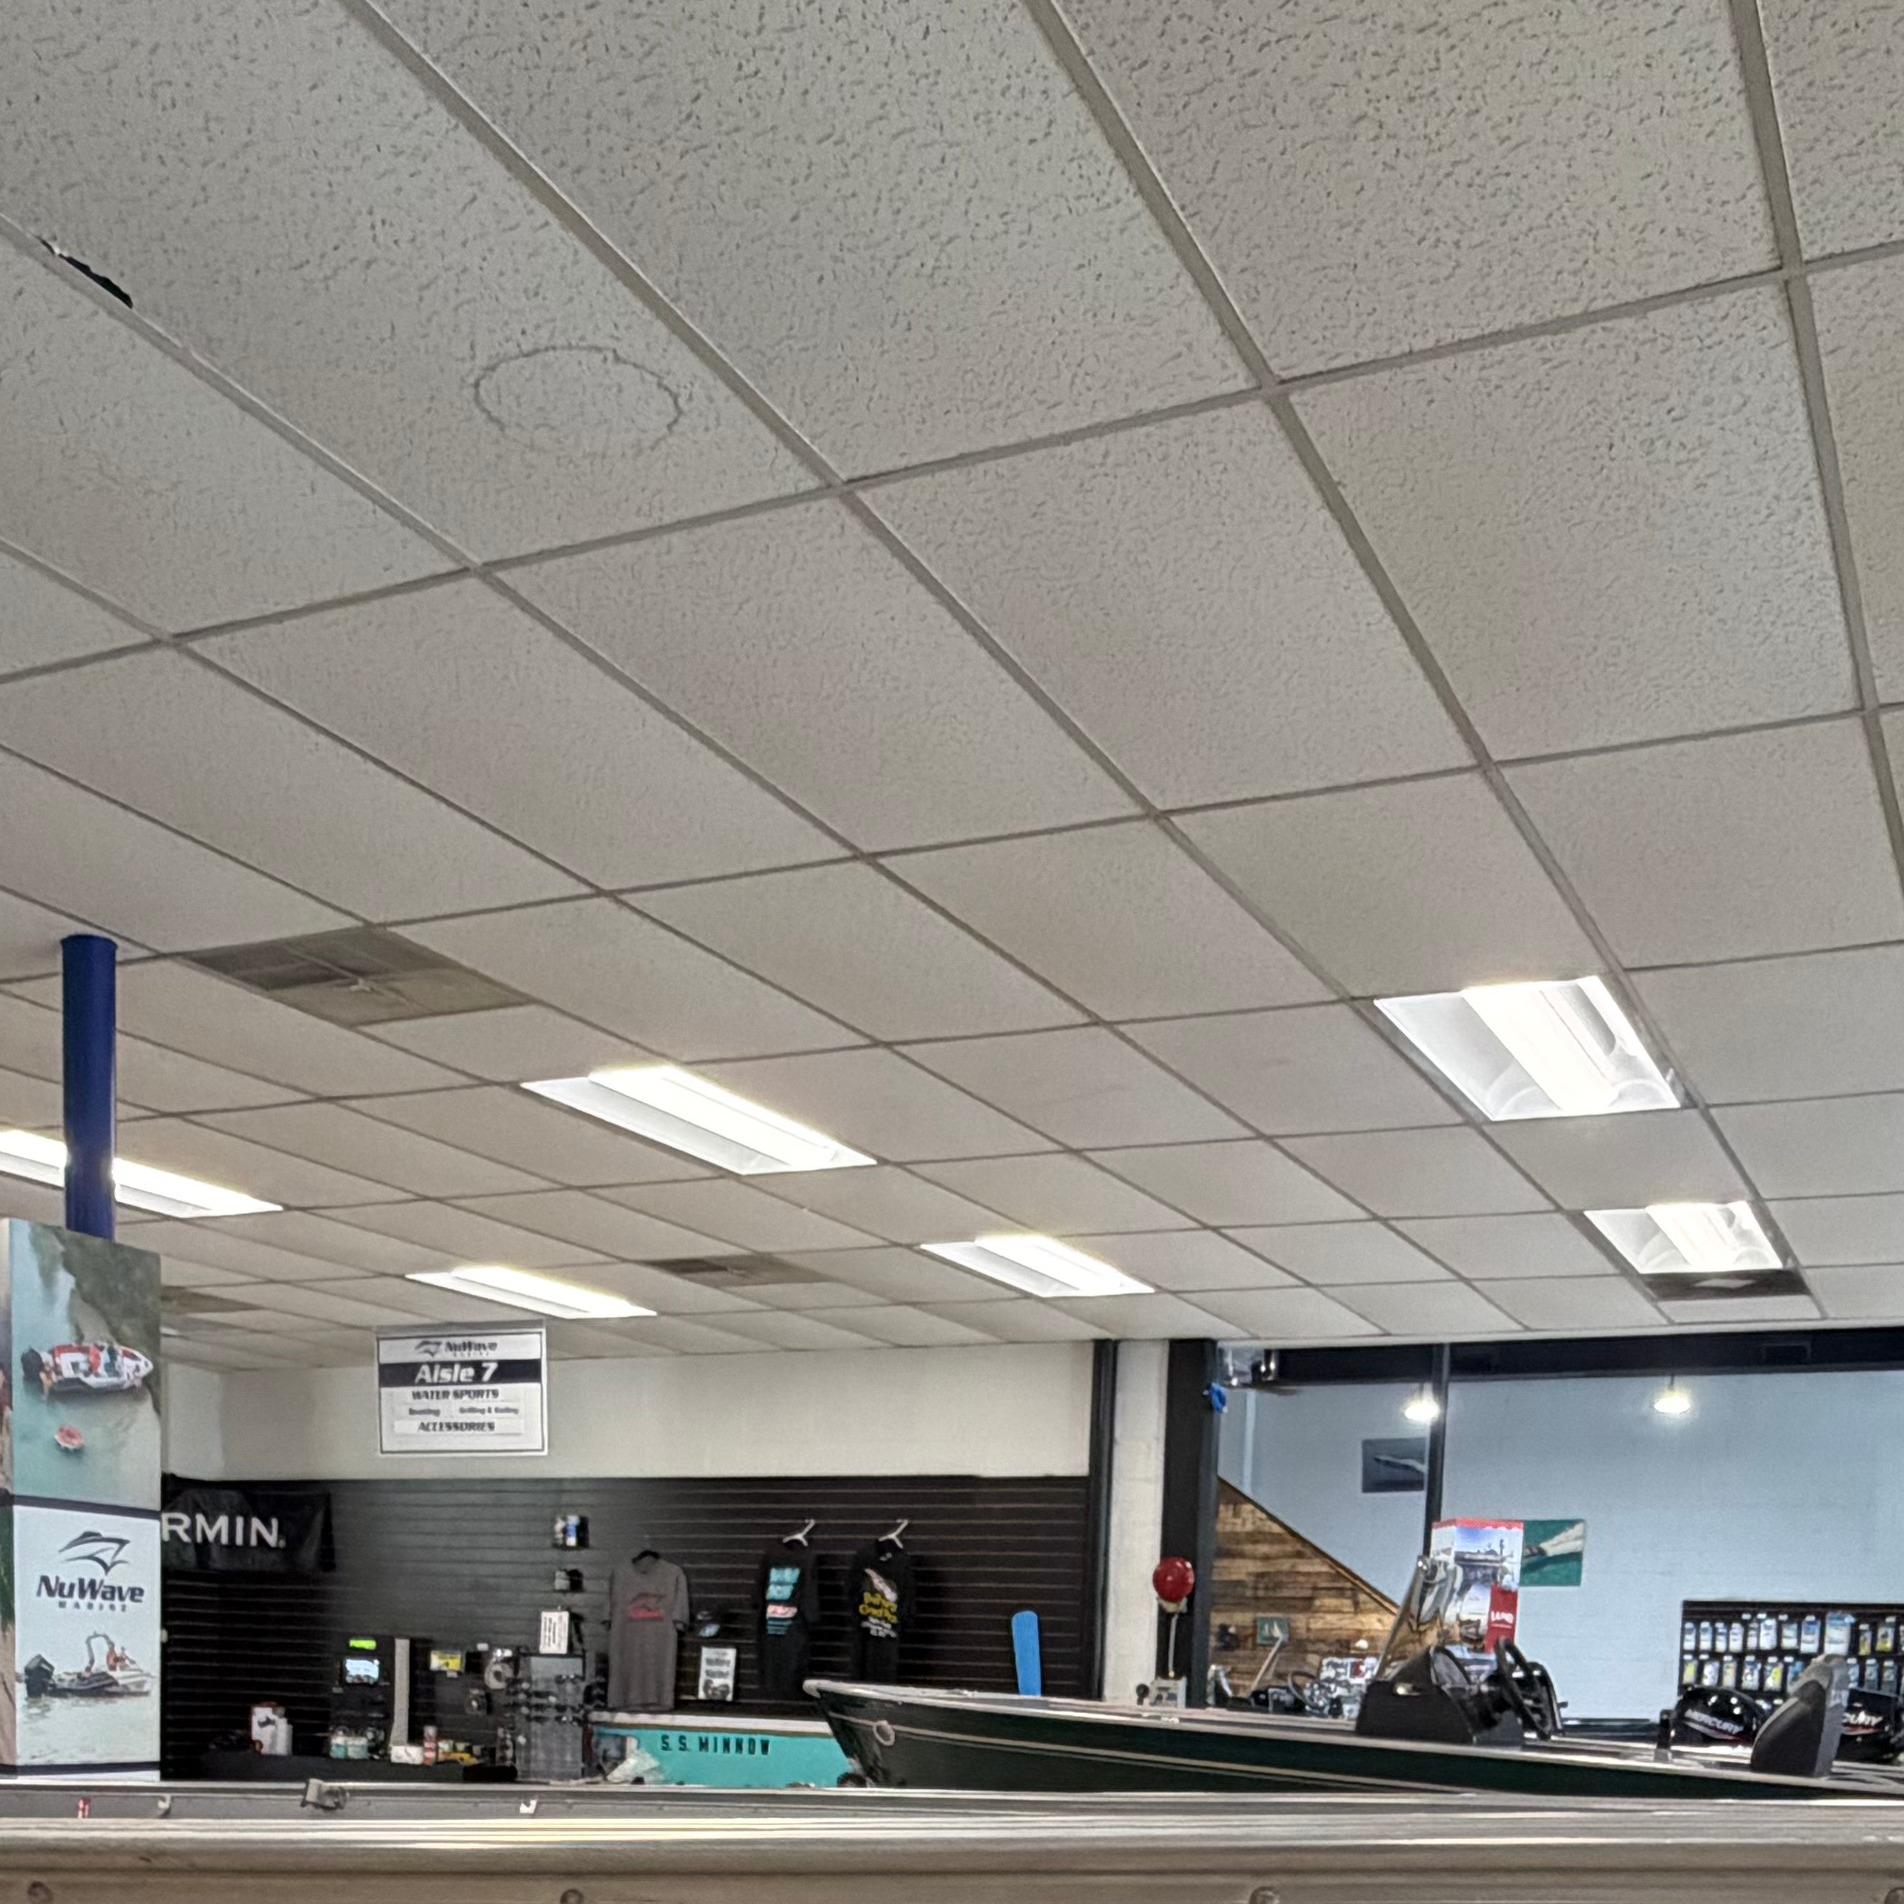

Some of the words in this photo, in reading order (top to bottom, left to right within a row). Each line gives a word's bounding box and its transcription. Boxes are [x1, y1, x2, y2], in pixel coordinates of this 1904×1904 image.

[415, 1363, 475, 1384] Aisle
[482, 1361, 498, 1382] 7
[160, 1512, 279, 1549] RMIN
[36, 1575, 145, 1603] NuWave
[698, 1736, 771, 1756] MINNOW
